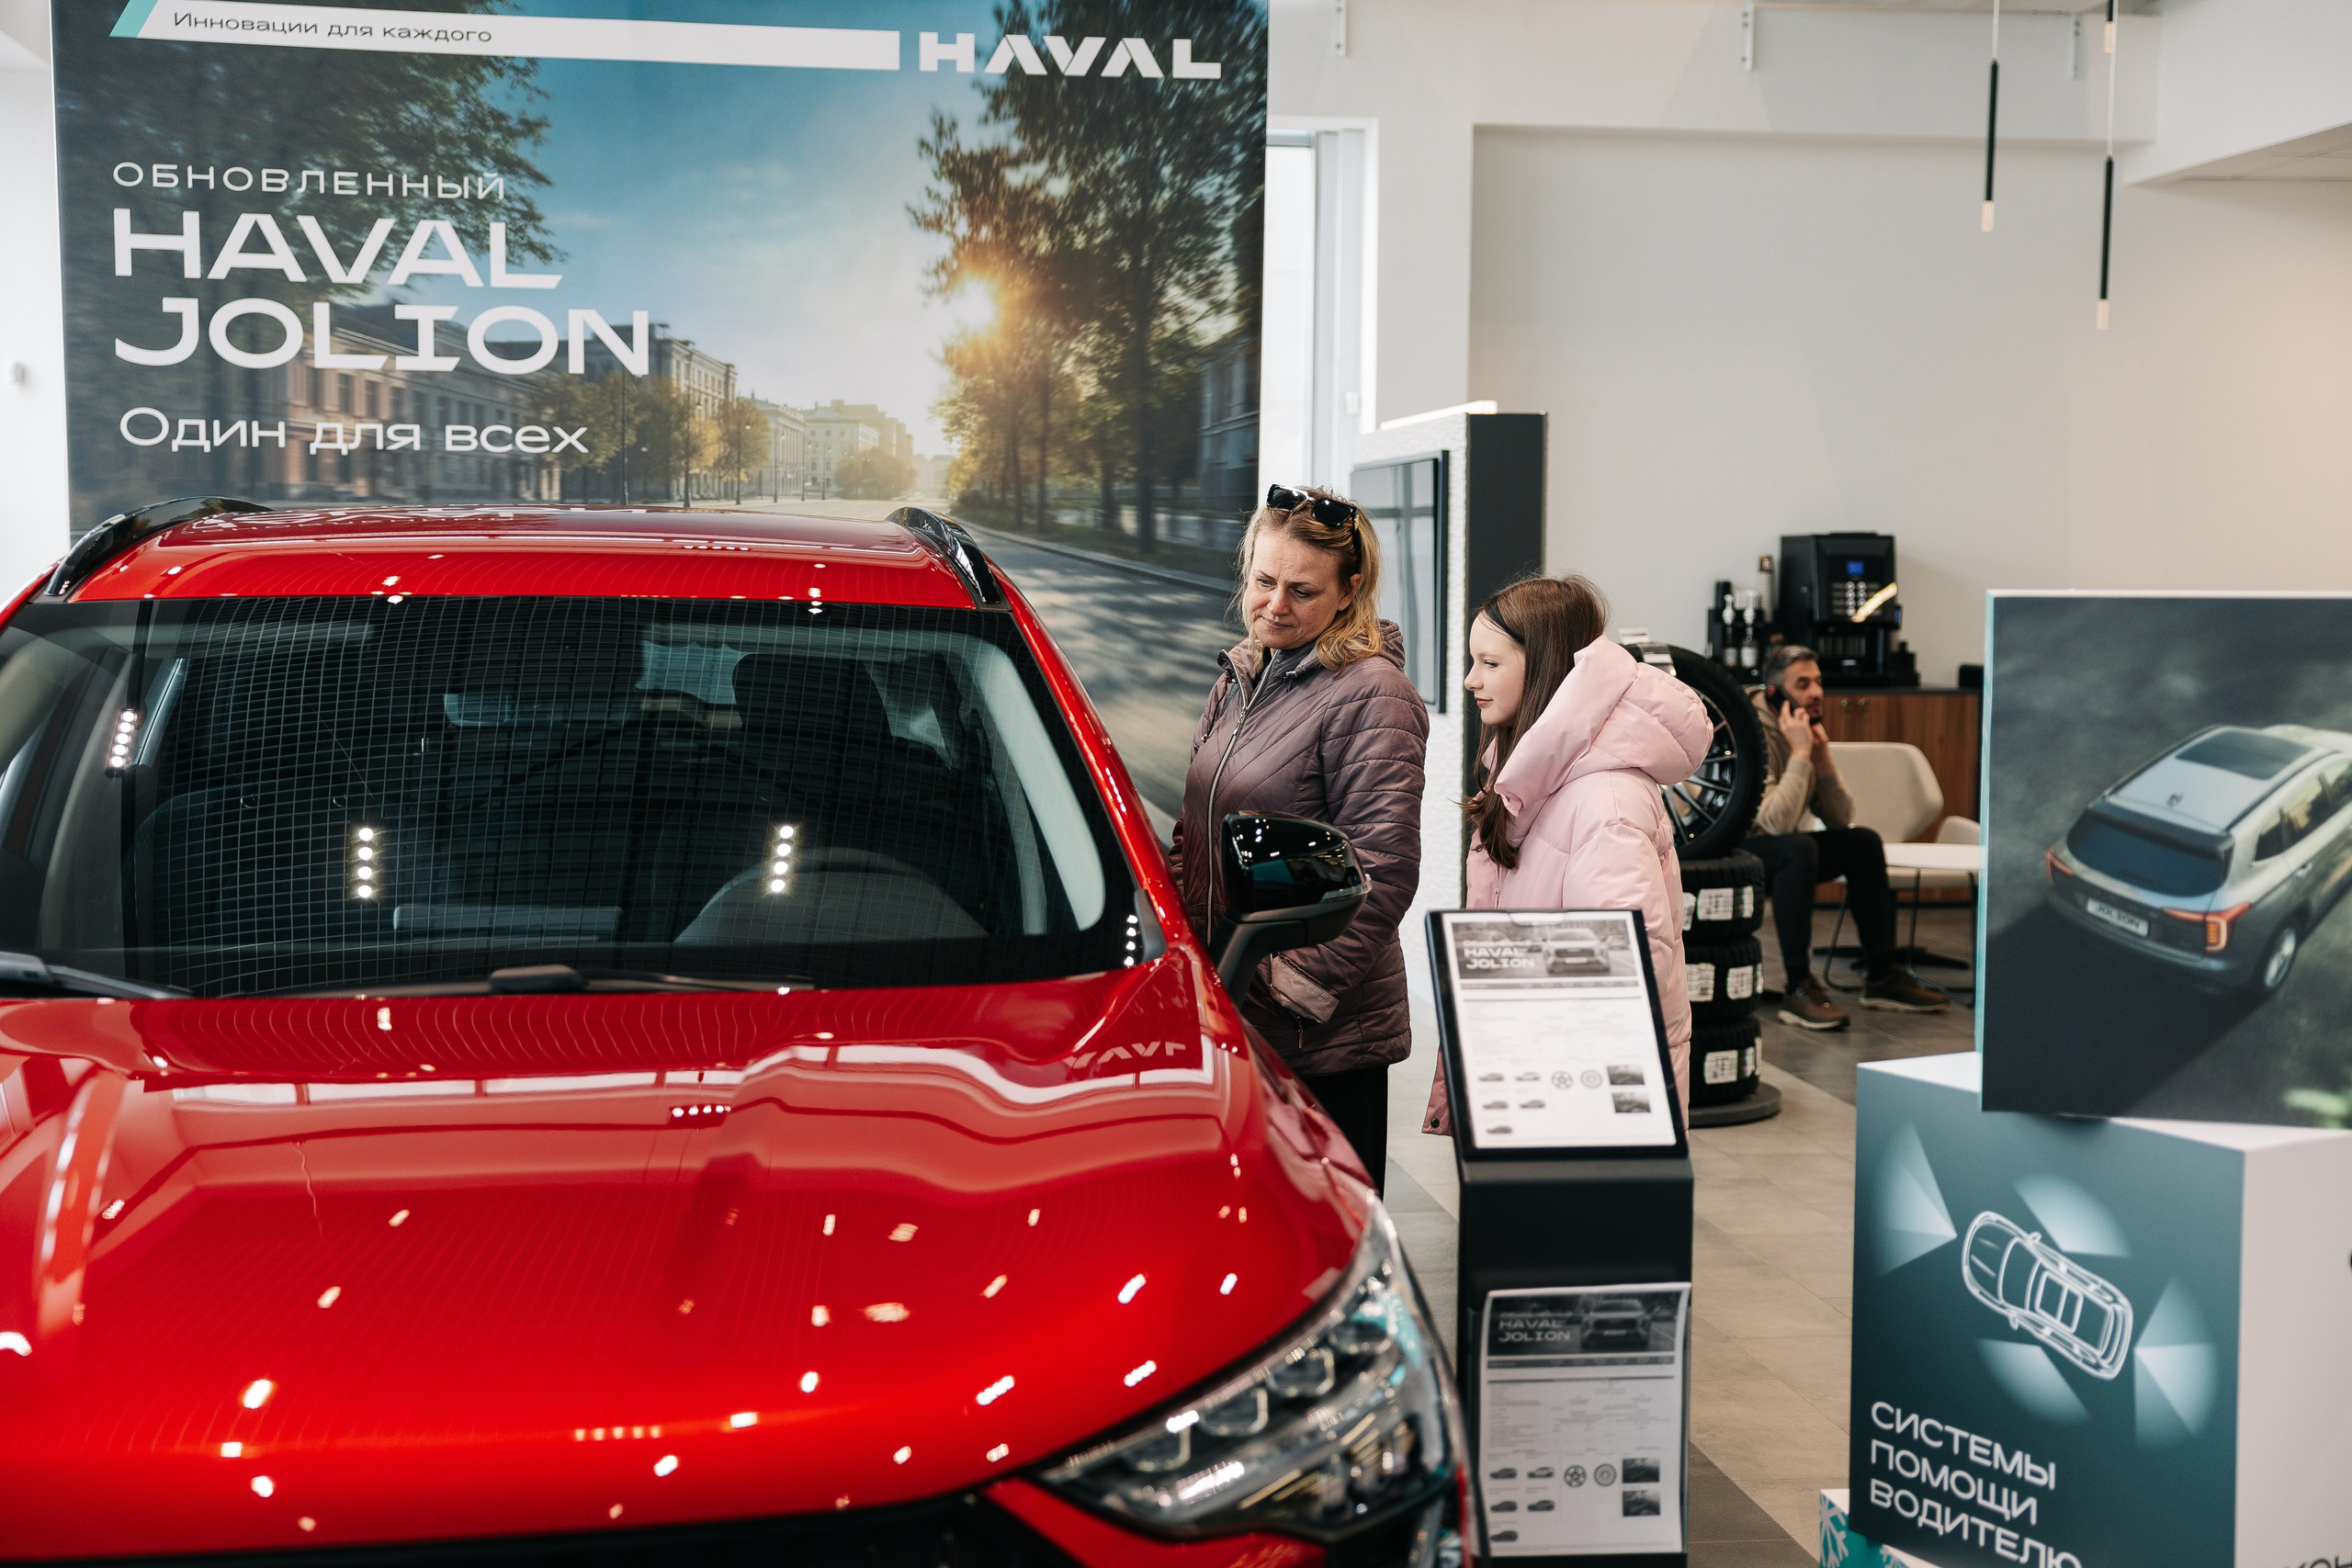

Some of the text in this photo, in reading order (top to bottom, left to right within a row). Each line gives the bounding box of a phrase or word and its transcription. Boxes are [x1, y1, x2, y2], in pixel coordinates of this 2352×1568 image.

[174, 12, 492, 42] Инновации для каждого
[920, 31, 1221, 79] HAVAL
[113, 162, 504, 200] ОБНОВЛЕННЫЙ
[113, 208, 563, 288] HAVAL
[115, 297, 650, 377] JOLION
[119, 406, 591, 456] Один для всех
[1464, 946, 1525, 958] HAVAL
[1465, 958, 1535, 970] JOLION
[1498, 1330, 1571, 1343] JOLION
[1499, 1319, 1563, 1330] HAVAL
[1871, 1401, 2056, 1491] СИСТЕМЫ
[1871, 1438, 2038, 1526] ПОМОЩИ
[1870, 1478, 2083, 1568] ВОДИТЕЛЮ
